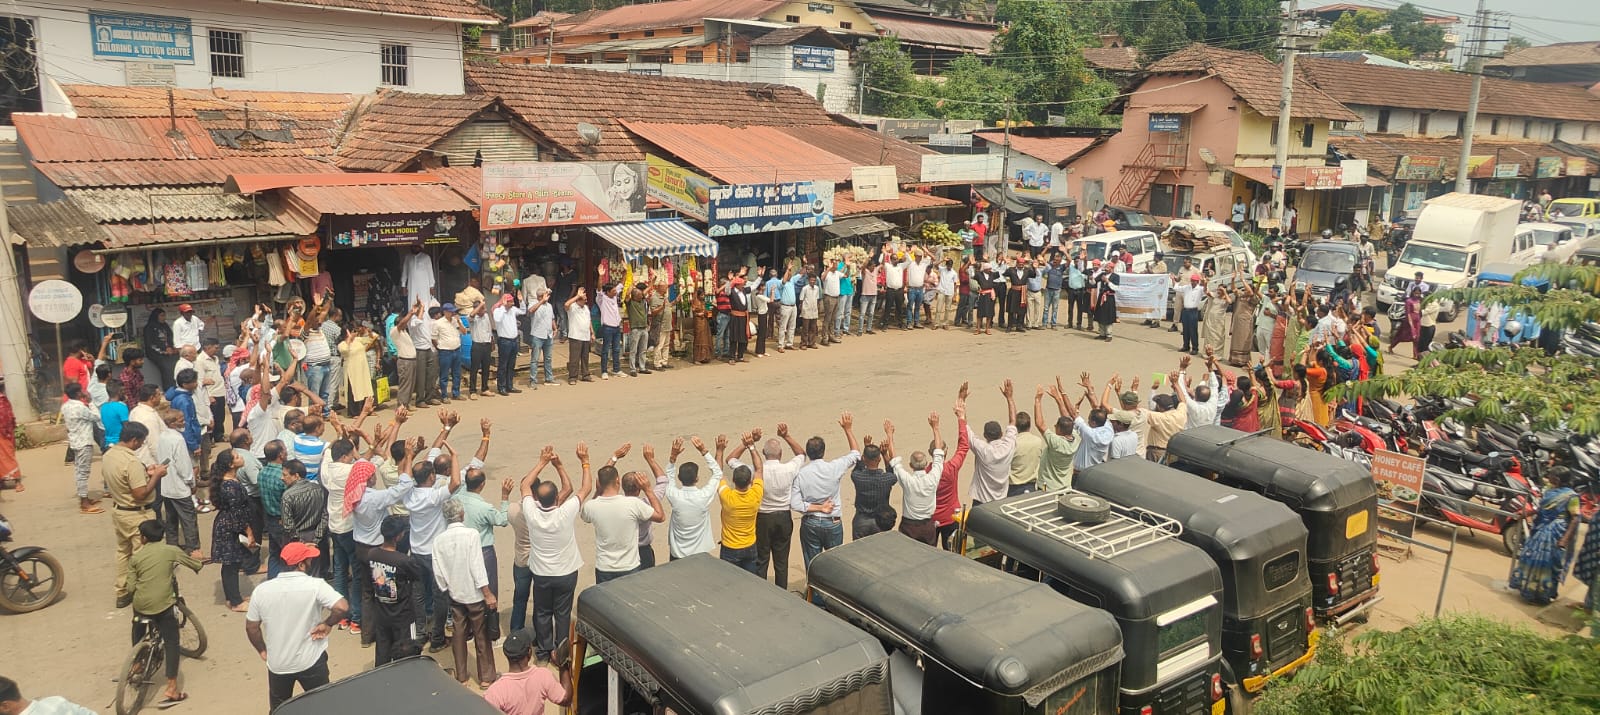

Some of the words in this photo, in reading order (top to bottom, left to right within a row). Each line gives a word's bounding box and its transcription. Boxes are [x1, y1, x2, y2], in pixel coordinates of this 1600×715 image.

[96, 42, 132, 54] TAILORING
[166, 47, 191, 57] CENTRE
[740, 206, 759, 218] BAKERY
[763, 204, 781, 217] SWEETS
[1374, 454, 1400, 467] HONEY
[1380, 468, 1397, 479] FAST
[1398, 472, 1418, 484] FOOD
[369, 560, 397, 573] SATORU
